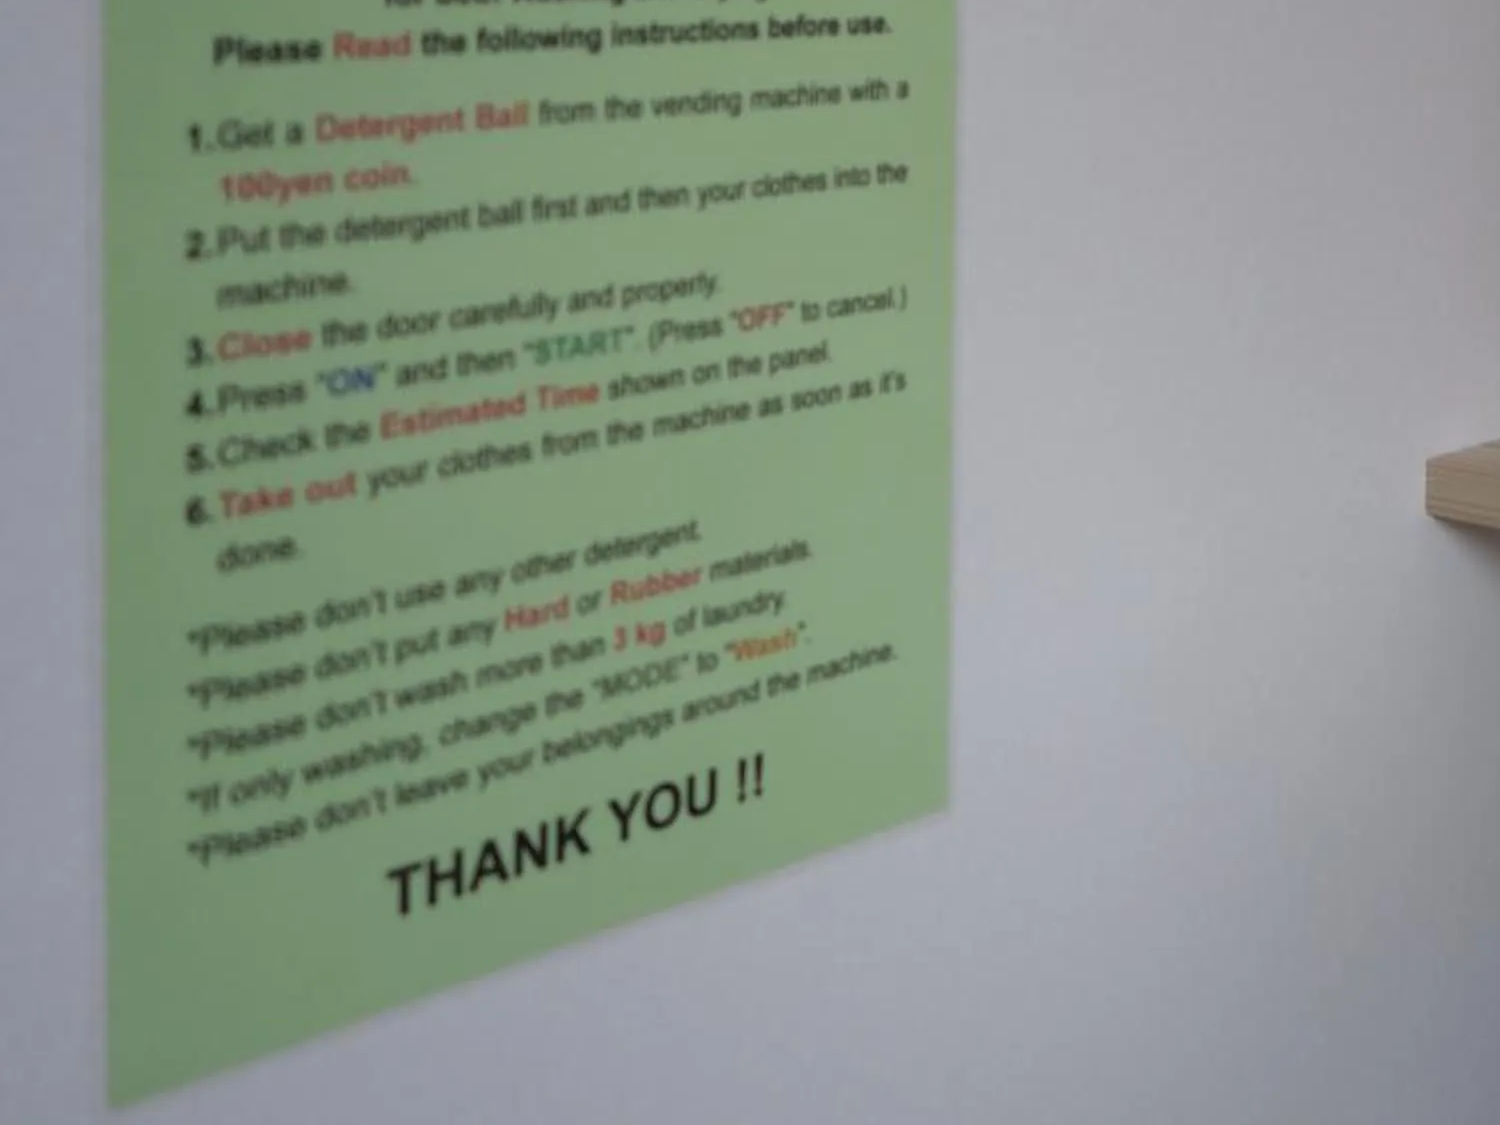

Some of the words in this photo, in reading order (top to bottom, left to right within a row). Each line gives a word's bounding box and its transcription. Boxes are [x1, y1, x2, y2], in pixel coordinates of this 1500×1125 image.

[213, 35, 323, 66] Please
[332, 30, 412, 59] Read
[420, 29, 466, 55] the
[477, 26, 602, 54] following
[611, 19, 759, 47] instructions
[767, 13, 840, 39] before
[847, 16, 893, 35] use.
[285, 124, 305, 146] a
[315, 108, 465, 145] Detergent
[474, 100, 531, 128] Ball
[539, 98, 597, 124] from
[605, 95, 642, 122] the
[652, 90, 743, 118] vending
[750, 83, 842, 111] machine
[849, 77, 889, 102] with
[896, 80, 909, 100] a
[278, 222, 327, 250] the
[334, 205, 471, 243] detergent
[477, 198, 525, 228] ball
[531, 194, 578, 221] first
[585, 189, 632, 216] and
[638, 184, 690, 211] then
[696, 181, 746, 211] your
[751, 171, 828, 199] clothes
[833, 165, 871, 189] into
[876, 162, 909, 185] the
[321, 320, 368, 348] the
[376, 312, 440, 340] door
[448, 290, 560, 330] carefully
[567, 283, 615, 315] and
[396, 355, 448, 388] and
[456, 350, 517, 377] then
[648, 316, 723, 352] (Press
[801, 300, 821, 322] to
[305, 470, 357, 504] out
[367, 459, 429, 499] your
[437, 442, 533, 479] clothes
[541, 428, 598, 459] from
[605, 419, 644, 446] the
[651, 399, 751, 437] machine
[758, 395, 784, 418] as
[790, 383, 842, 412] soon
[848, 377, 873, 399] as
[878, 369, 907, 394] it's
[324, 422, 371, 451] the
[379, 392, 527, 441] Estimated
[536, 381, 599, 410] Time
[607, 367, 686, 402] shown
[691, 362, 720, 386] on
[726, 353, 762, 380] the
[314, 588, 387, 629] don't
[395, 580, 447, 610] use
[454, 568, 505, 599] any
[511, 548, 577, 583] other
[314, 639, 387, 679] don't
[395, 628, 440, 665] put
[447, 619, 497, 647] any
[504, 593, 570, 633] Hard
[576, 590, 603, 616] or
[609, 567, 703, 605] Rubber
[314, 689, 387, 732] don't
[394, 669, 469, 709] wash
[475, 652, 544, 687] more
[551, 637, 606, 667] than
[614, 625, 627, 652] 3
[635, 620, 667, 648] kg
[673, 608, 697, 636] of
[227, 768, 294, 806] only
[438, 701, 537, 748] change
[545, 689, 584, 719] the
[696, 651, 719, 675] to
[314, 787, 387, 834] don't
[394, 768, 469, 806] leave
[477, 748, 535, 793] your
[542, 706, 675, 764] belongings
[681, 680, 761, 723] around
[767, 671, 800, 697] the
[386, 805, 591, 917] THANK
[609, 766, 718, 842] YOU
[736, 752, 764, 804] !!
